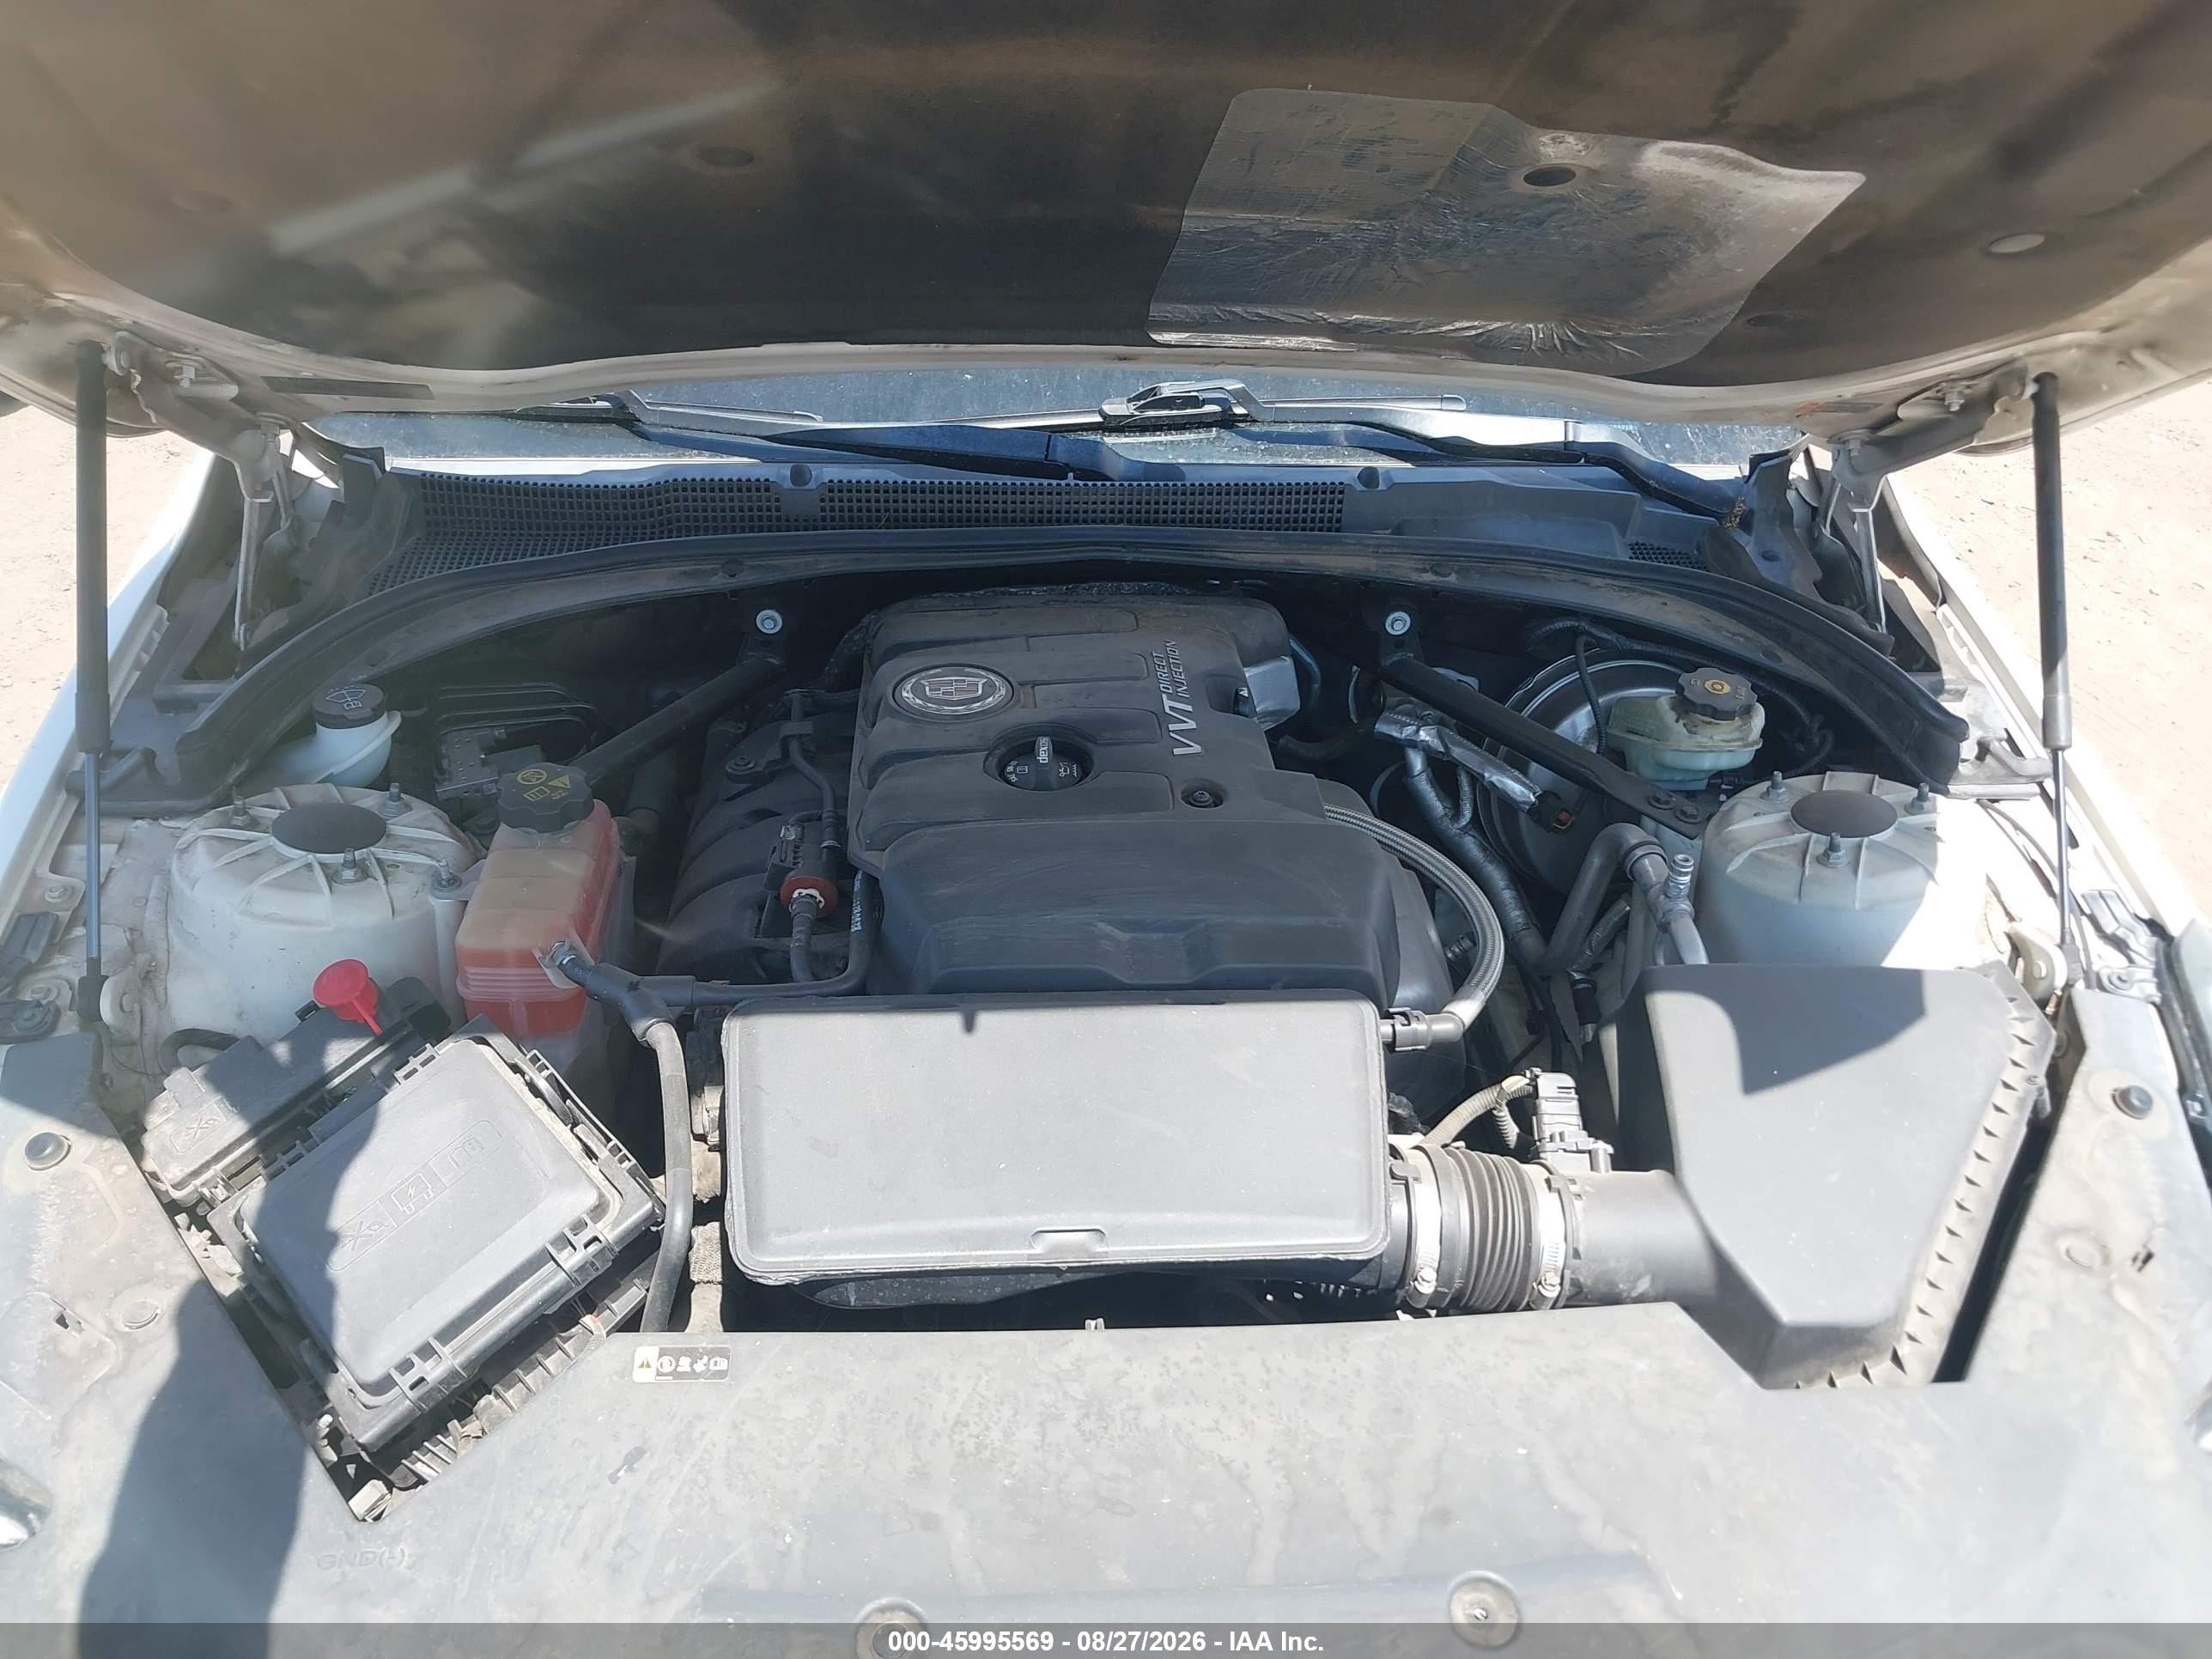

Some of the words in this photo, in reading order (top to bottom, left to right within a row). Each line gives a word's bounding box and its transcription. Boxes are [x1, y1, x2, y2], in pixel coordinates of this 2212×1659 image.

[1152, 650, 1173, 694] DIRECT
[1163, 639, 1190, 698] INJECTION
[1161, 693, 1203, 756] VVT
